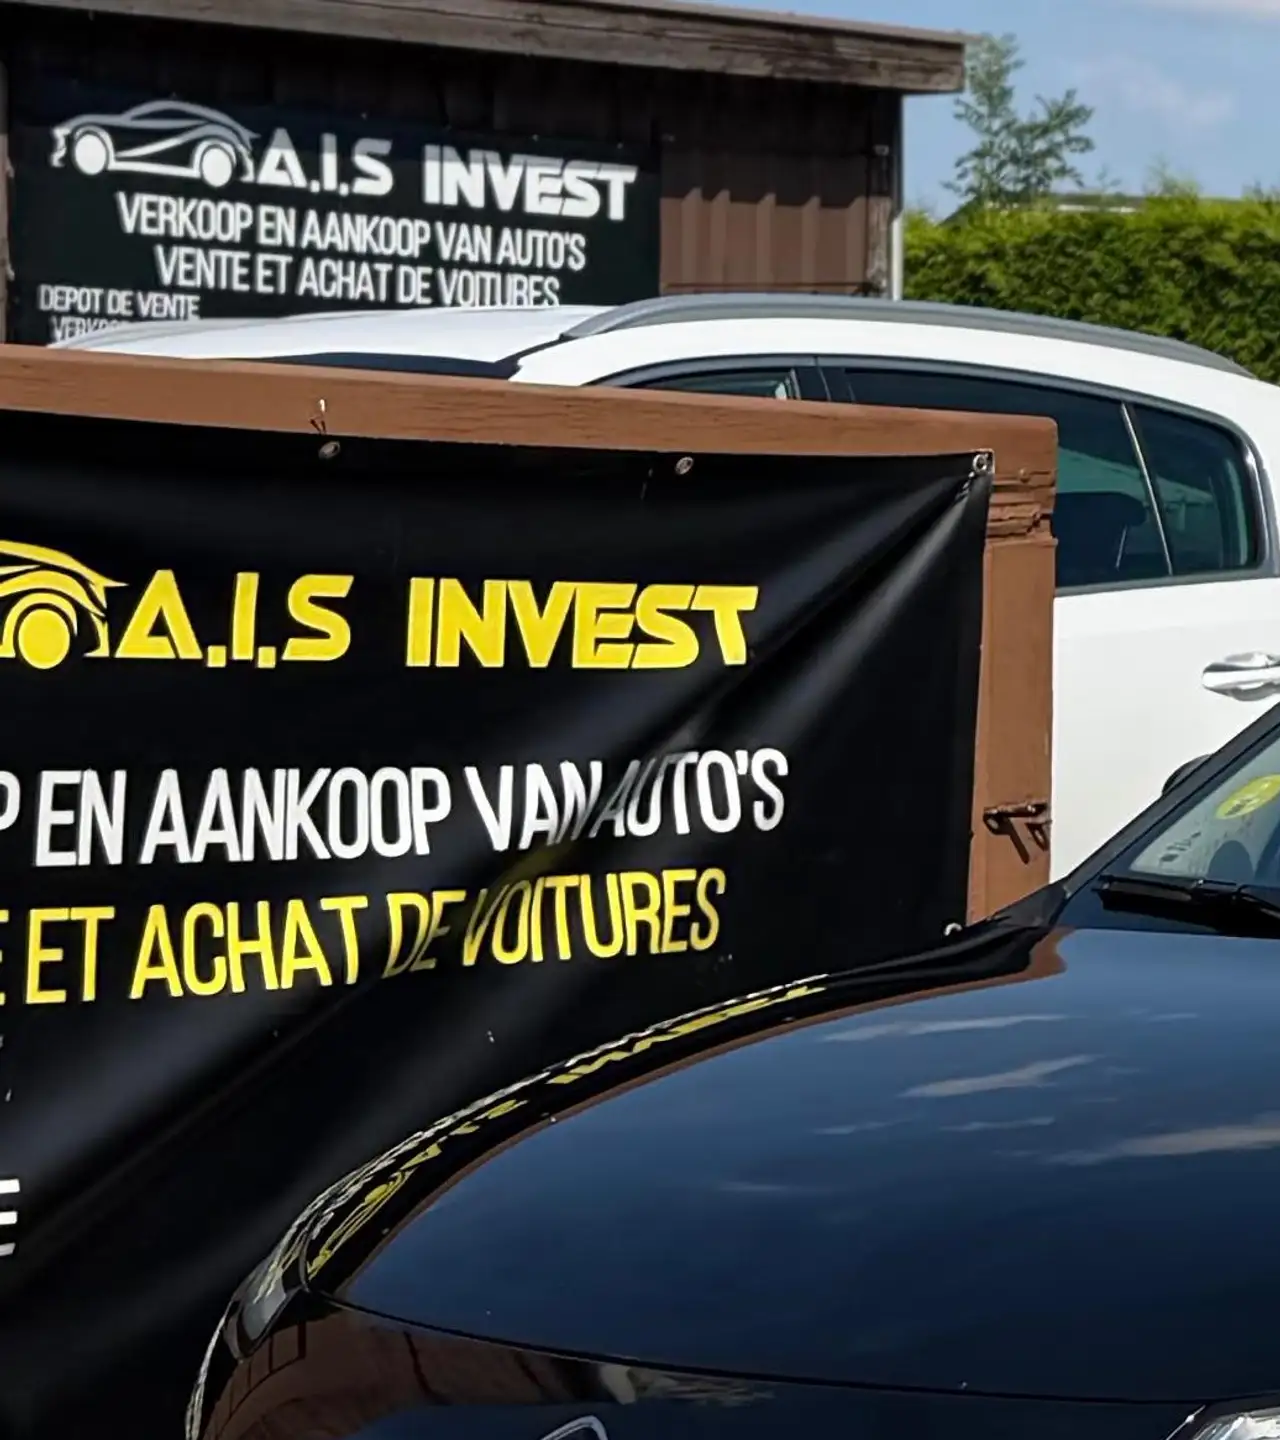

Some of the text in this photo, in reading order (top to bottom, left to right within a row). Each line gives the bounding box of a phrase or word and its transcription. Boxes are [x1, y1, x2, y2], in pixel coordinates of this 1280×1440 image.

[257, 129, 637, 221] A.I.S INVEST
[117, 191, 586, 272] VERKOOP EN AANKOOP VAN AUTO'S
[154, 244, 561, 307] VENTE ET ACHAT DE VOITURES
[38, 284, 200, 320] DEPOT DE VENTE
[115, 569, 759, 670] A.I.S INVEST
[34, 768, 127, 867] EN
[139, 766, 452, 866] AANKOOP
[463, 760, 603, 852] VAN
[587, 748, 789, 839] AUTO'S
[25, 906, 116, 1005] ET
[128, 895, 369, 1000] ACHAT
[384, 889, 467, 977] DE
[462, 868, 726, 967] VOITURES
